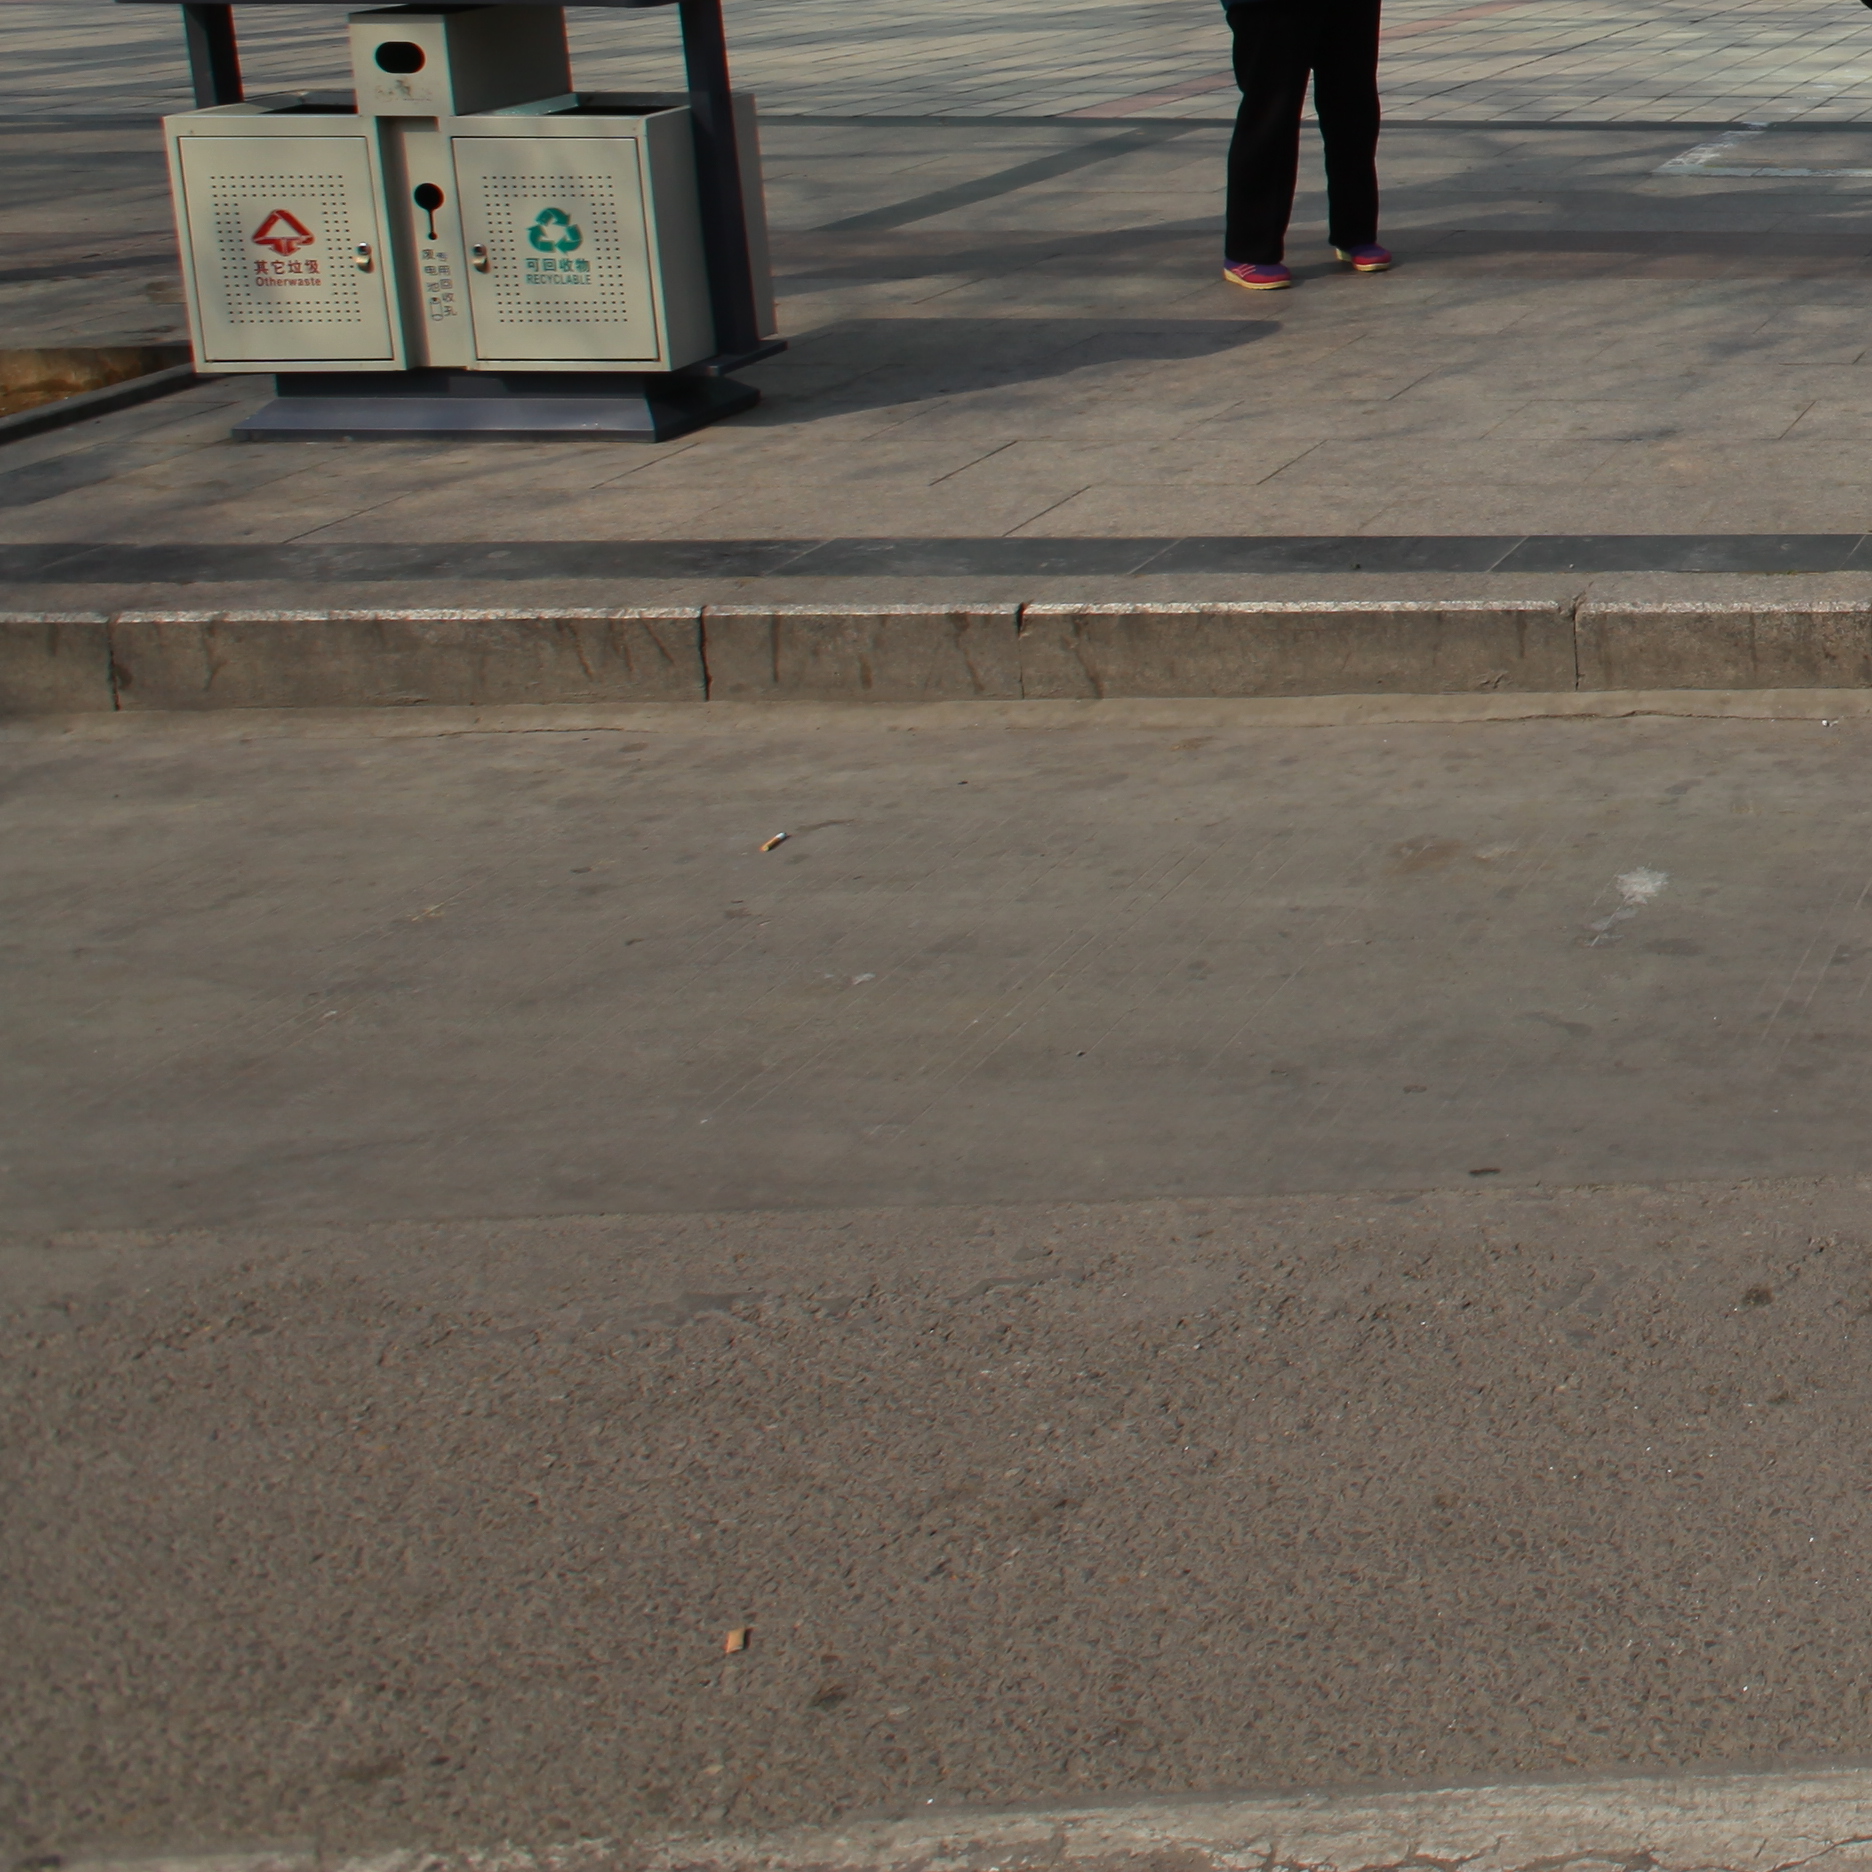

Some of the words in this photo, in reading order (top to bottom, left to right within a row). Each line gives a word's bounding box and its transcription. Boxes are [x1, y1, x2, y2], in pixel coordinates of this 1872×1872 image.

[254, 259, 320, 275] 其它垃圾
[525, 257, 592, 273] 可回收物
[255, 276, 321, 287] Otherwaste
[525, 273, 592, 286] RECYCLABLE
